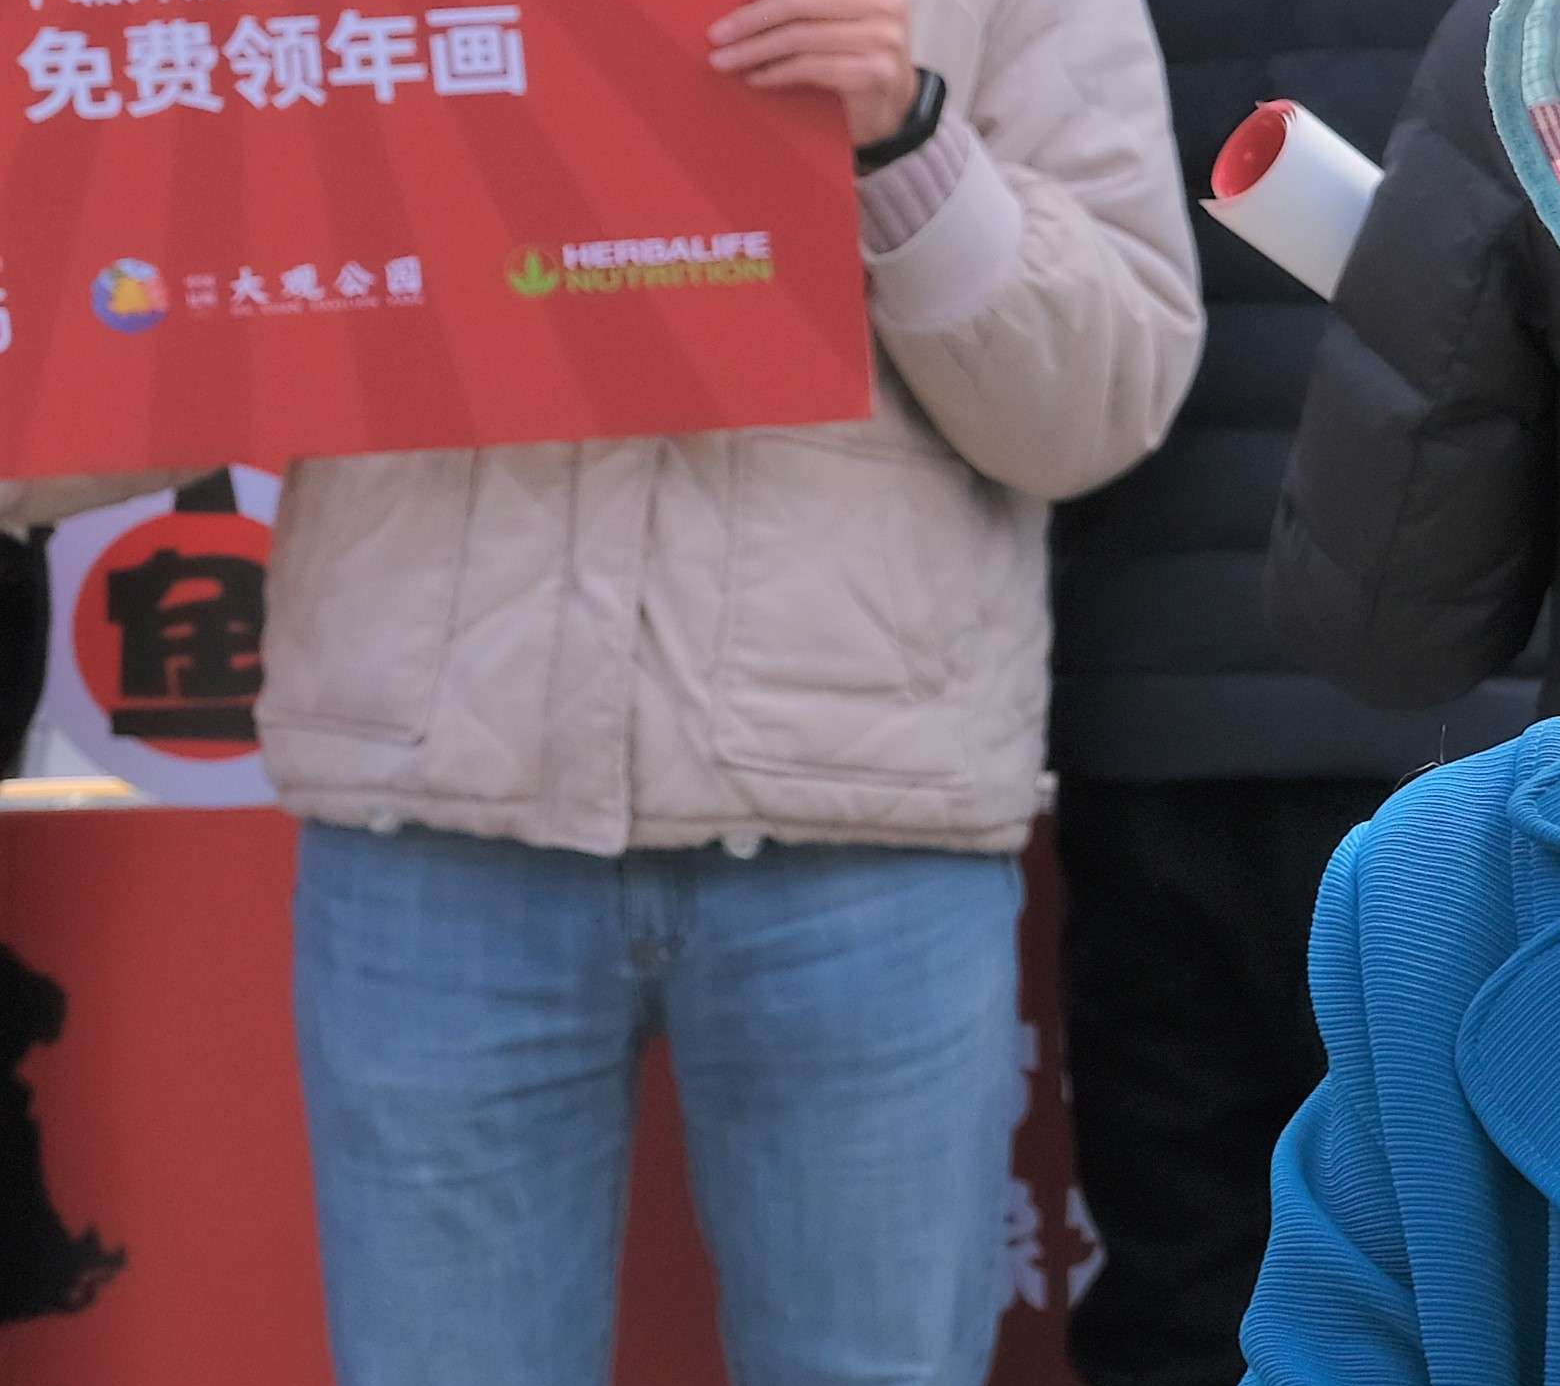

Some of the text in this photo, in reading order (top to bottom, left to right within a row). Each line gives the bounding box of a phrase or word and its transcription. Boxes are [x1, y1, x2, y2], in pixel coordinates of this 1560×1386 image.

[17, 4, 526, 124] 免费领年画
[561, 229, 772, 272] HERBALIFE
[563, 258, 774, 294] NUTRITION
